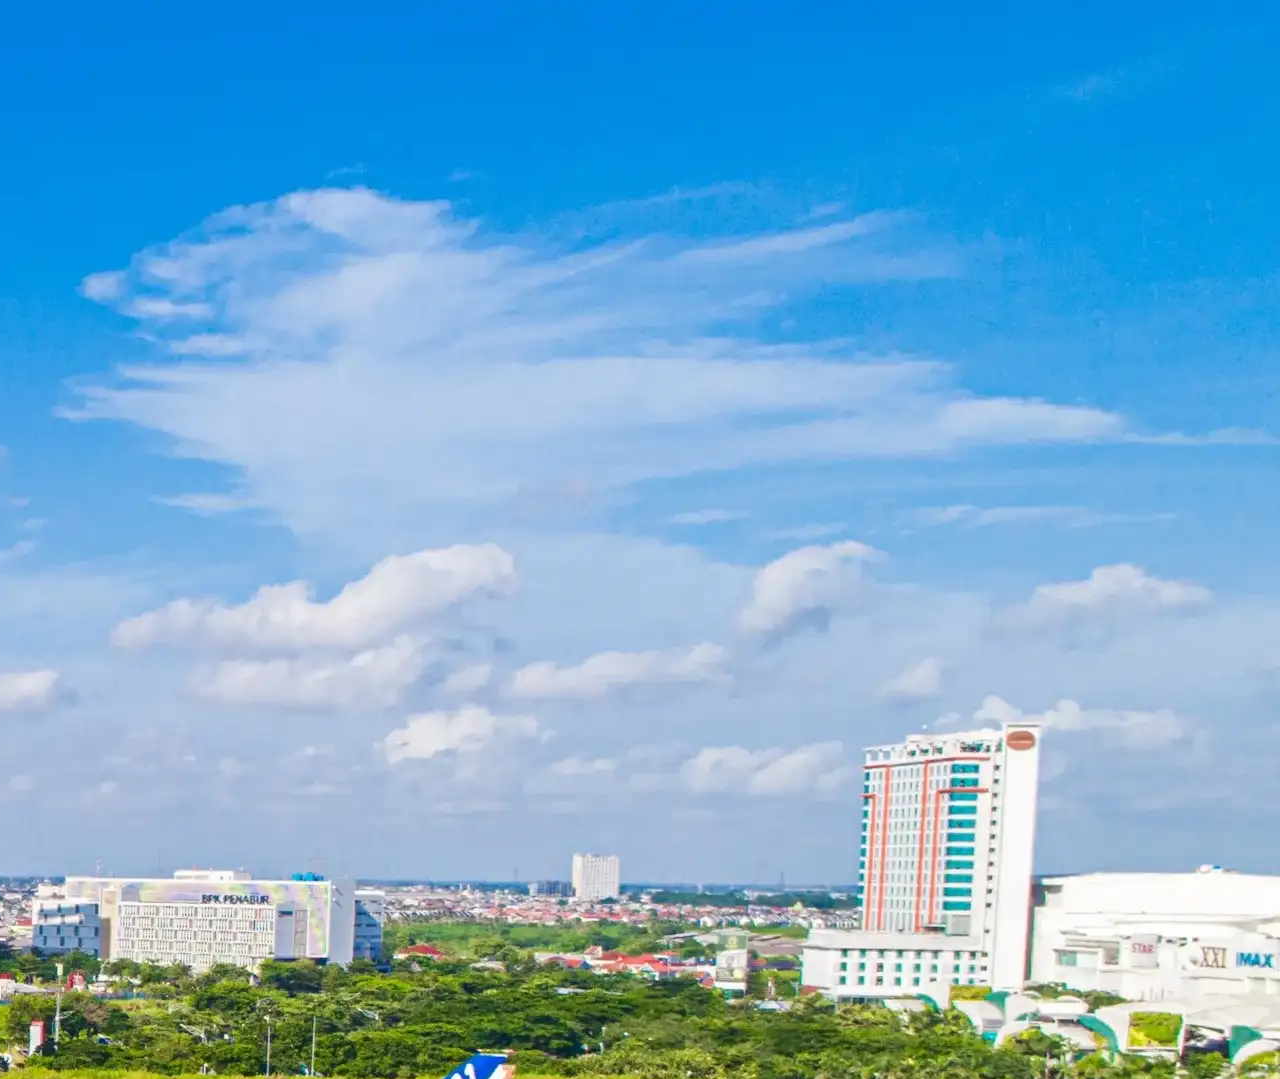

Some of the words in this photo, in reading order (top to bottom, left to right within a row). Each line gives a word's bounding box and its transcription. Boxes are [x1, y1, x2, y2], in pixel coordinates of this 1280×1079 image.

[201, 894, 221, 904] BPK
[1201, 947, 1227, 969] XXI
[1236, 951, 1274, 969] IMAX
